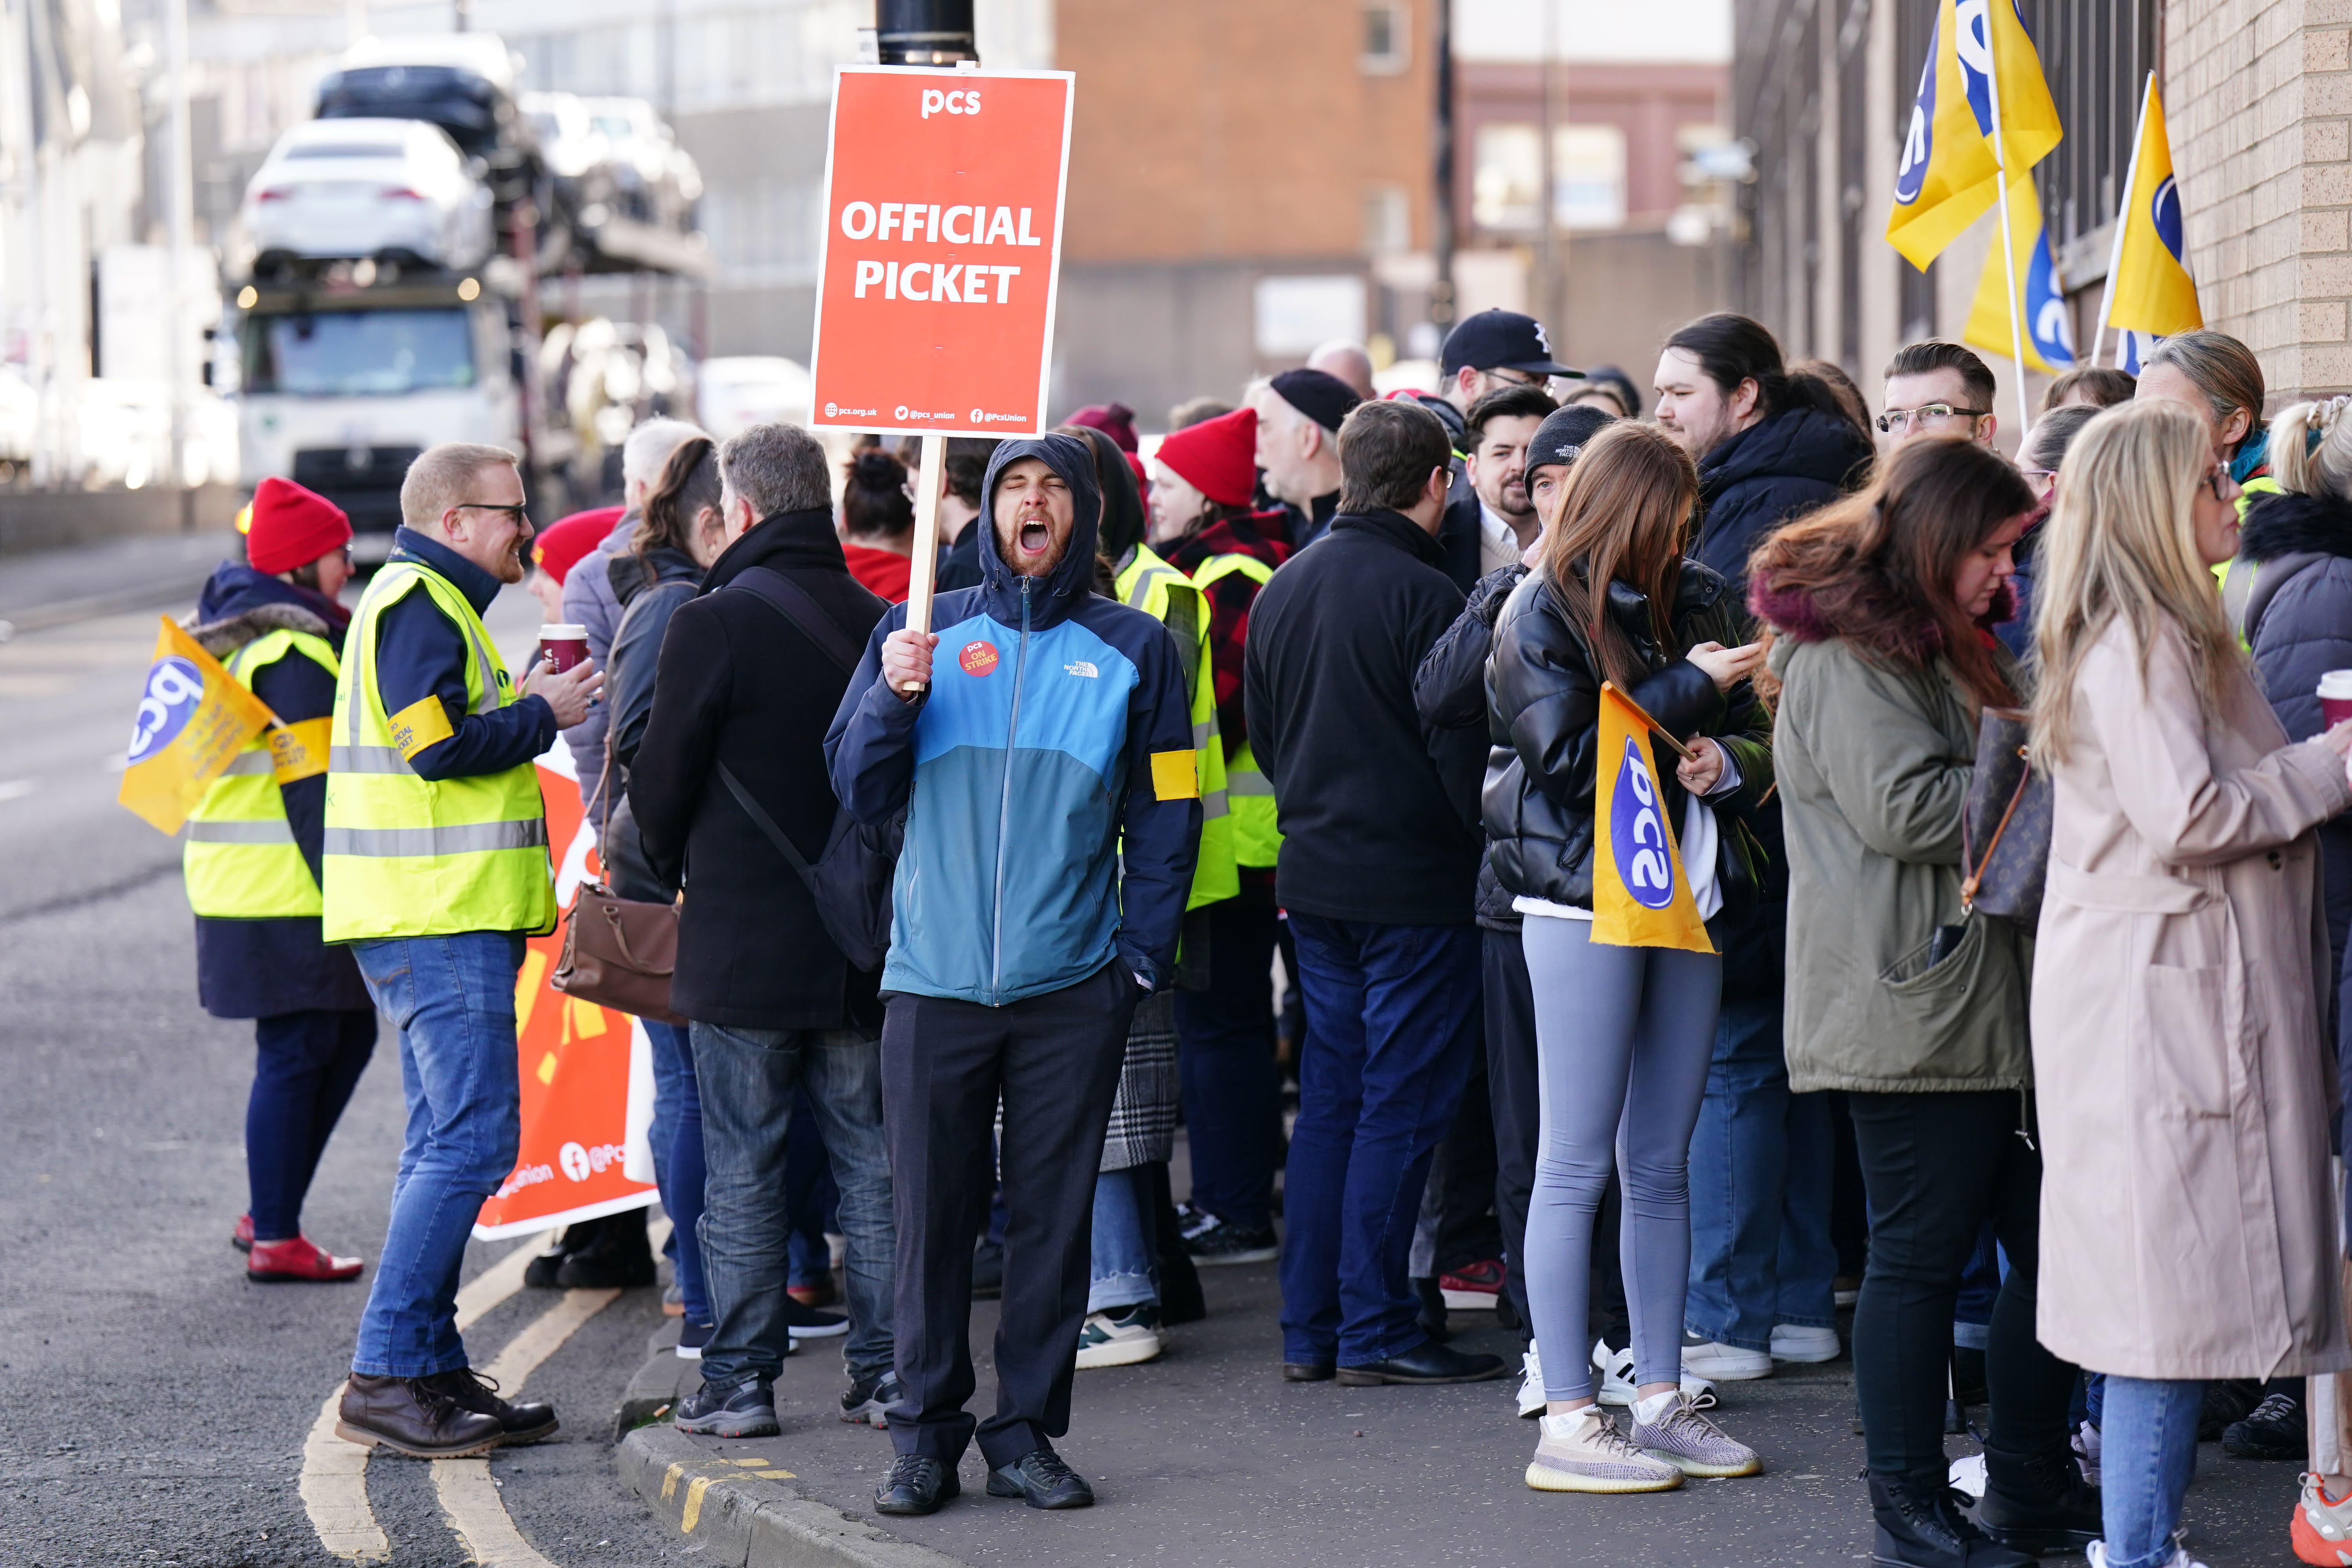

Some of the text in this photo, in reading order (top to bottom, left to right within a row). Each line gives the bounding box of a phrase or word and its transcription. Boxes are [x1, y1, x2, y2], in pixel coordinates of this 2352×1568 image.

[921, 89, 981, 119] pcs
[841, 201, 1041, 246] OFFICIAL
[854, 260, 1021, 304] PICKET
[838, 407, 877, 417] pcs.org.uk
[910, 410, 955, 420] @pcs_union
[984, 412, 1027, 423] @PcsUnion
[967, 642, 983, 653] pcs
[971, 650, 986, 660] ON
[965, 653, 997, 671] STRIKE
[390, 722, 399, 732] pcs
[394, 726, 414, 744] FFICIAL
